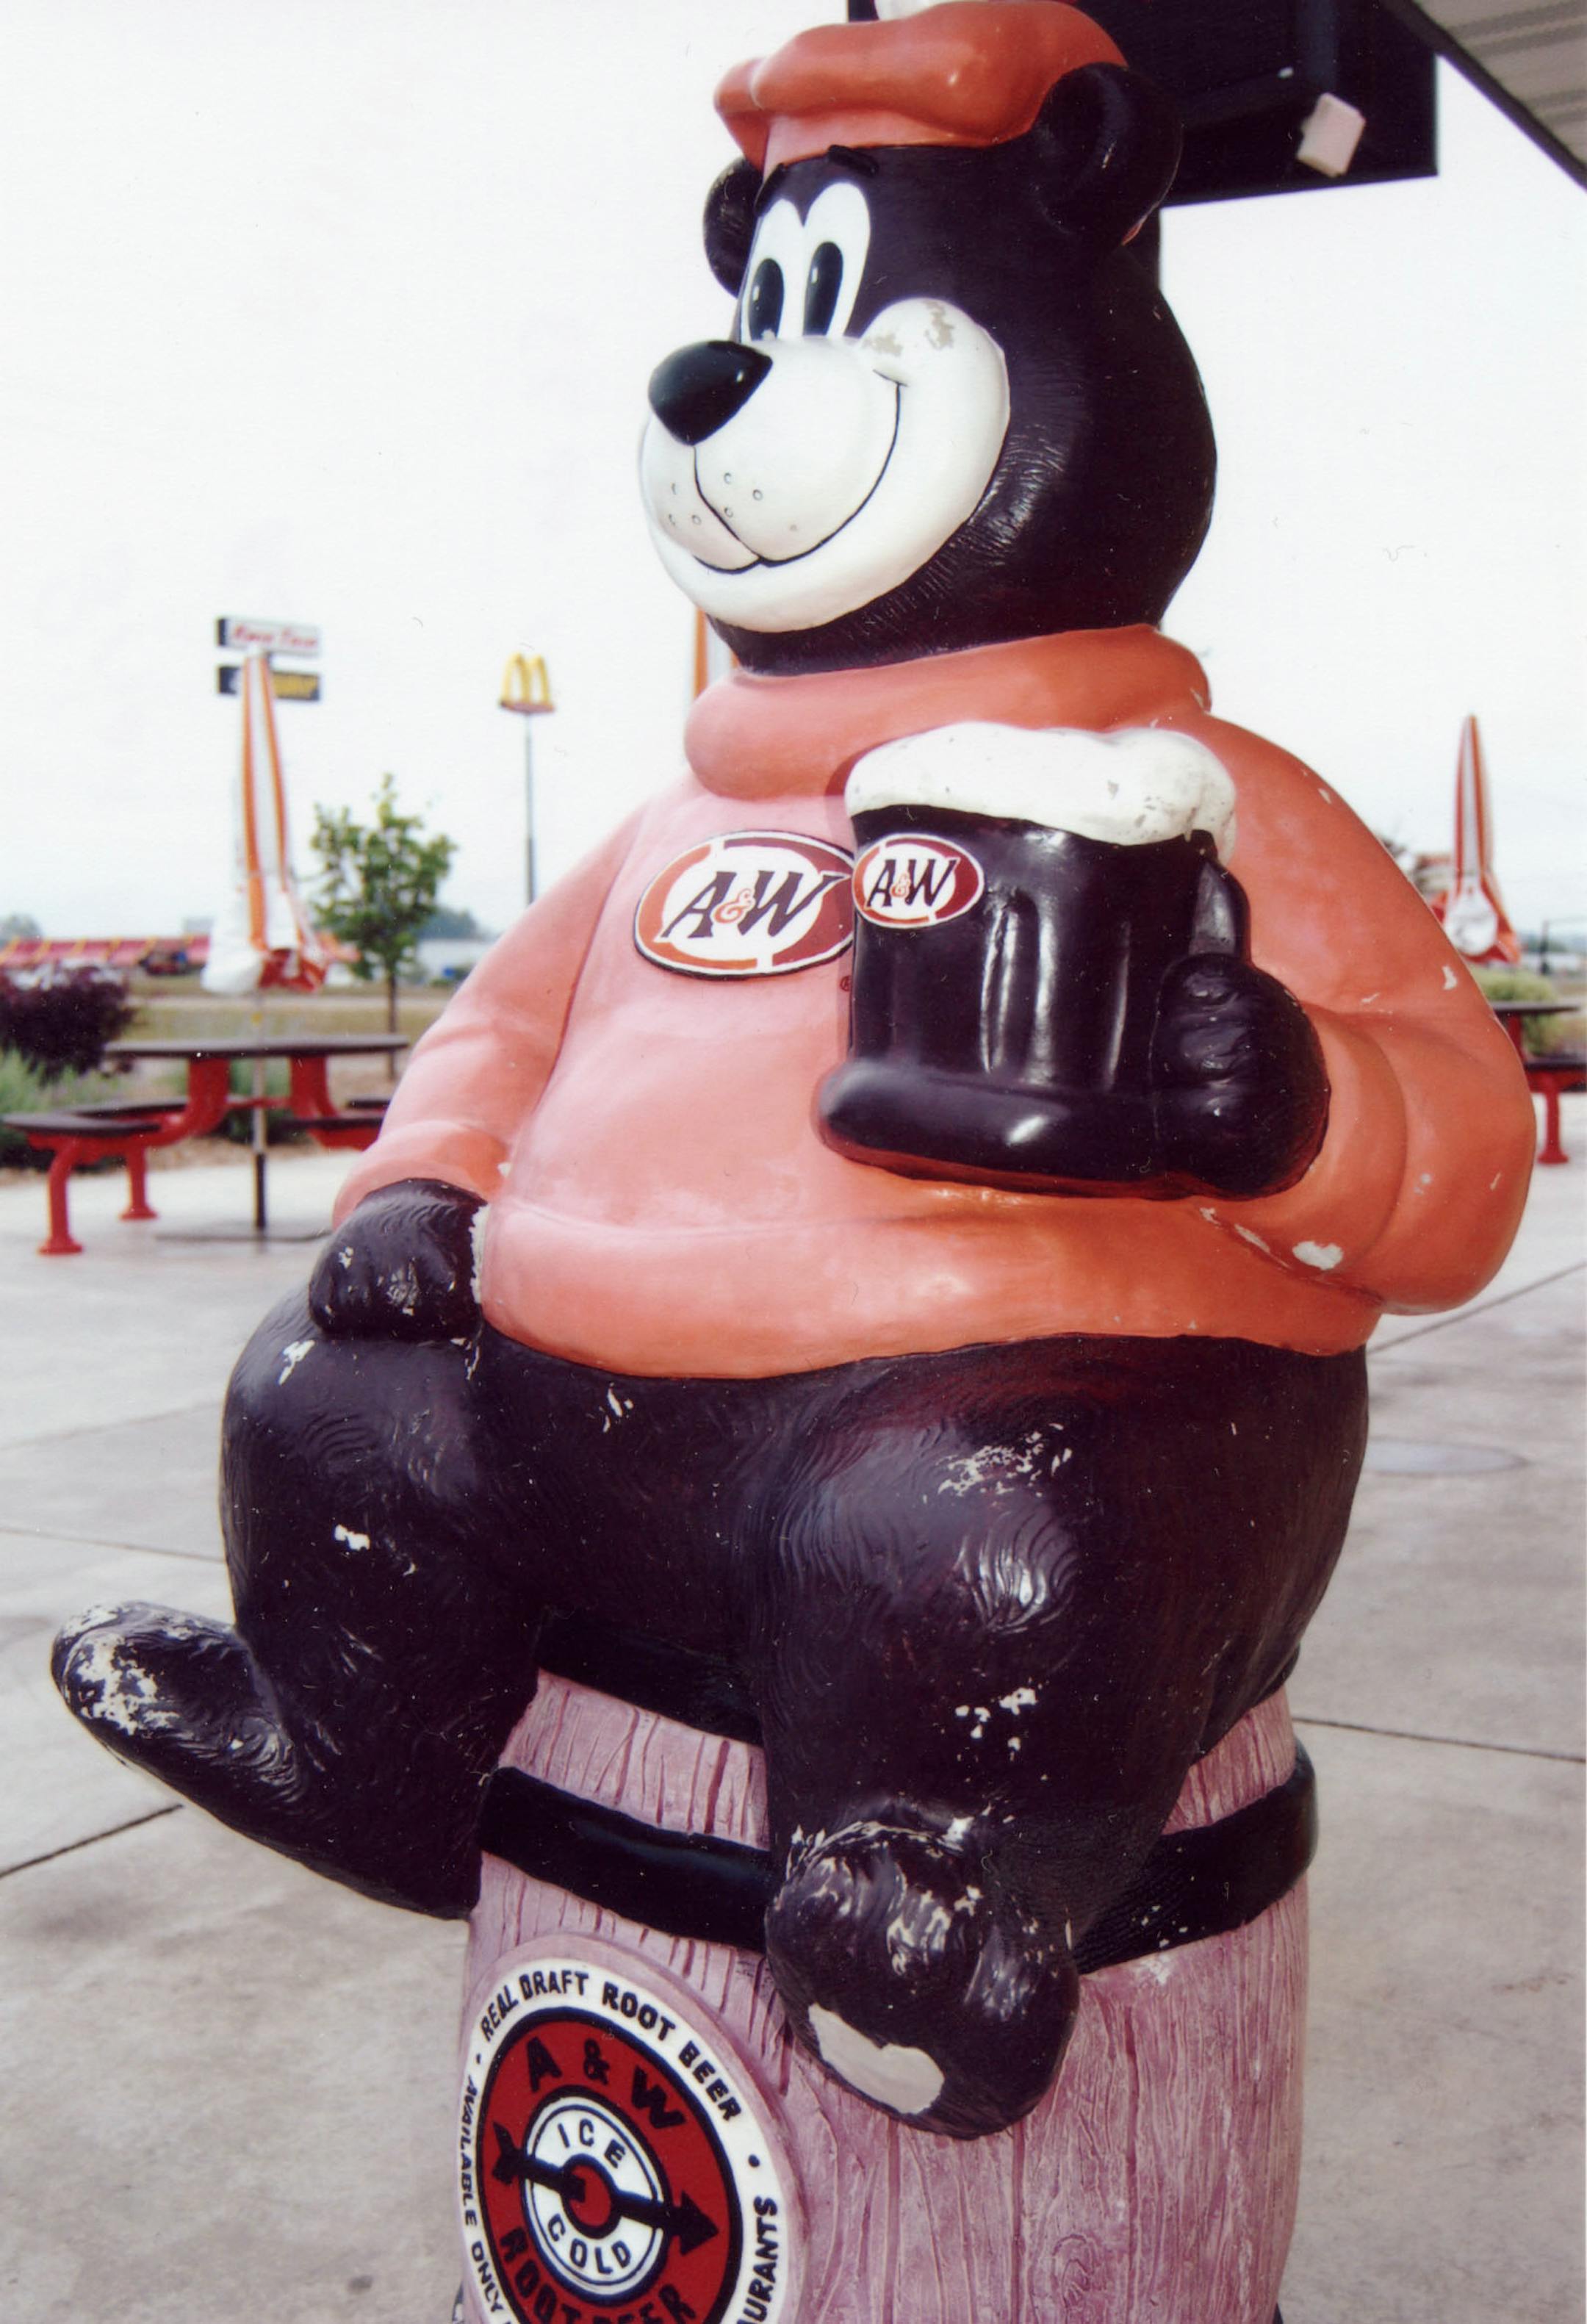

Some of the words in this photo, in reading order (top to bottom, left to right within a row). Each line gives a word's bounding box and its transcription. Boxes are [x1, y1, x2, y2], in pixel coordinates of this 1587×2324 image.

[661, 870, 847, 939] A&W
[865, 858, 957, 908] A&W
[481, 1985, 519, 2043] REAL
[519, 1970, 590, 2001] DRAFT
[602, 1981, 676, 2041] ROOT
[678, 2040, 741, 2122] BEER
[557, 2118, 626, 2170] ICE
[460, 2075, 478, 2227] AVAILABLE
[471, 2241, 505, 2313] ONLY
[499, 2226, 582, 2324] ROOT
[547, 2213, 631, 2275] COLD
[736, 2195, 778, 2324] URANTS
